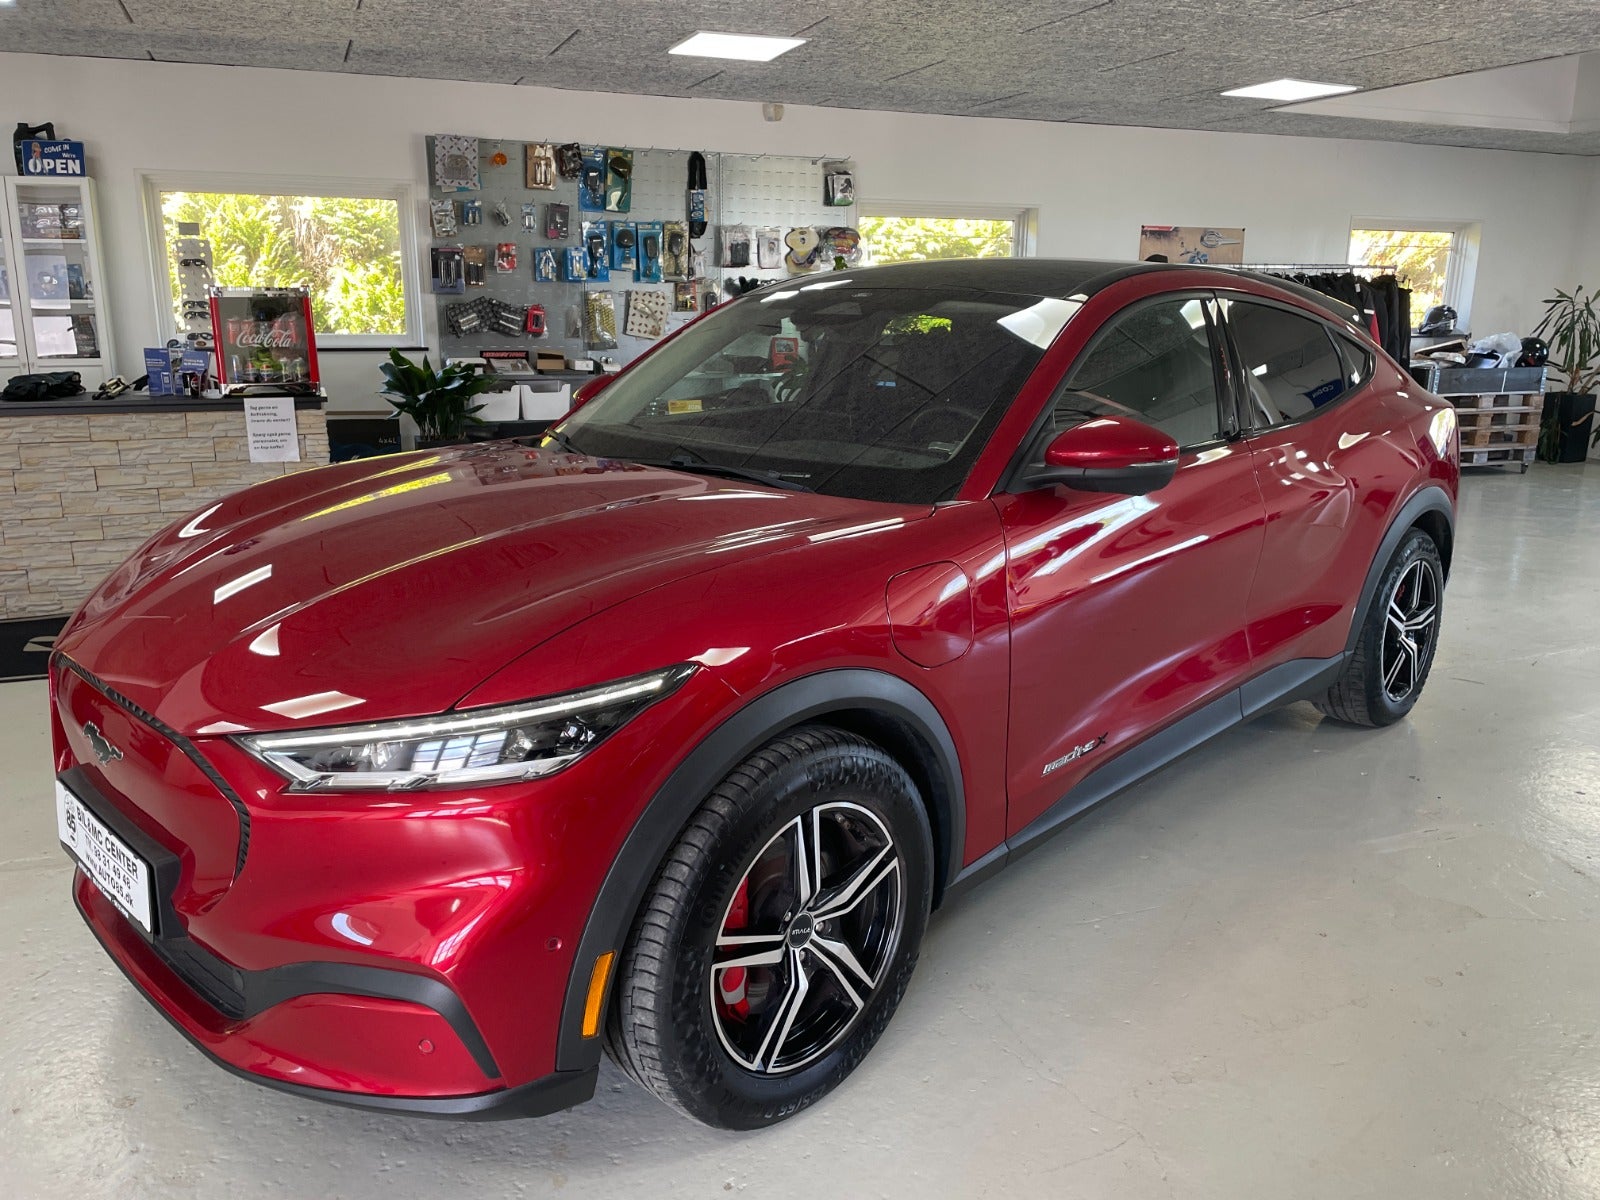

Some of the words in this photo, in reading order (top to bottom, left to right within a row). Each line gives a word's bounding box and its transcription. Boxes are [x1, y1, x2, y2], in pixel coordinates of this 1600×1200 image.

[44, 145, 62, 153] COME
[28, 158, 81, 175] OPEN
[236, 329, 293, 348] Coca-Cola
[66, 810, 77, 834] 85
[76, 806, 103, 846] BIL&MC
[104, 836, 139, 880] CENTER
